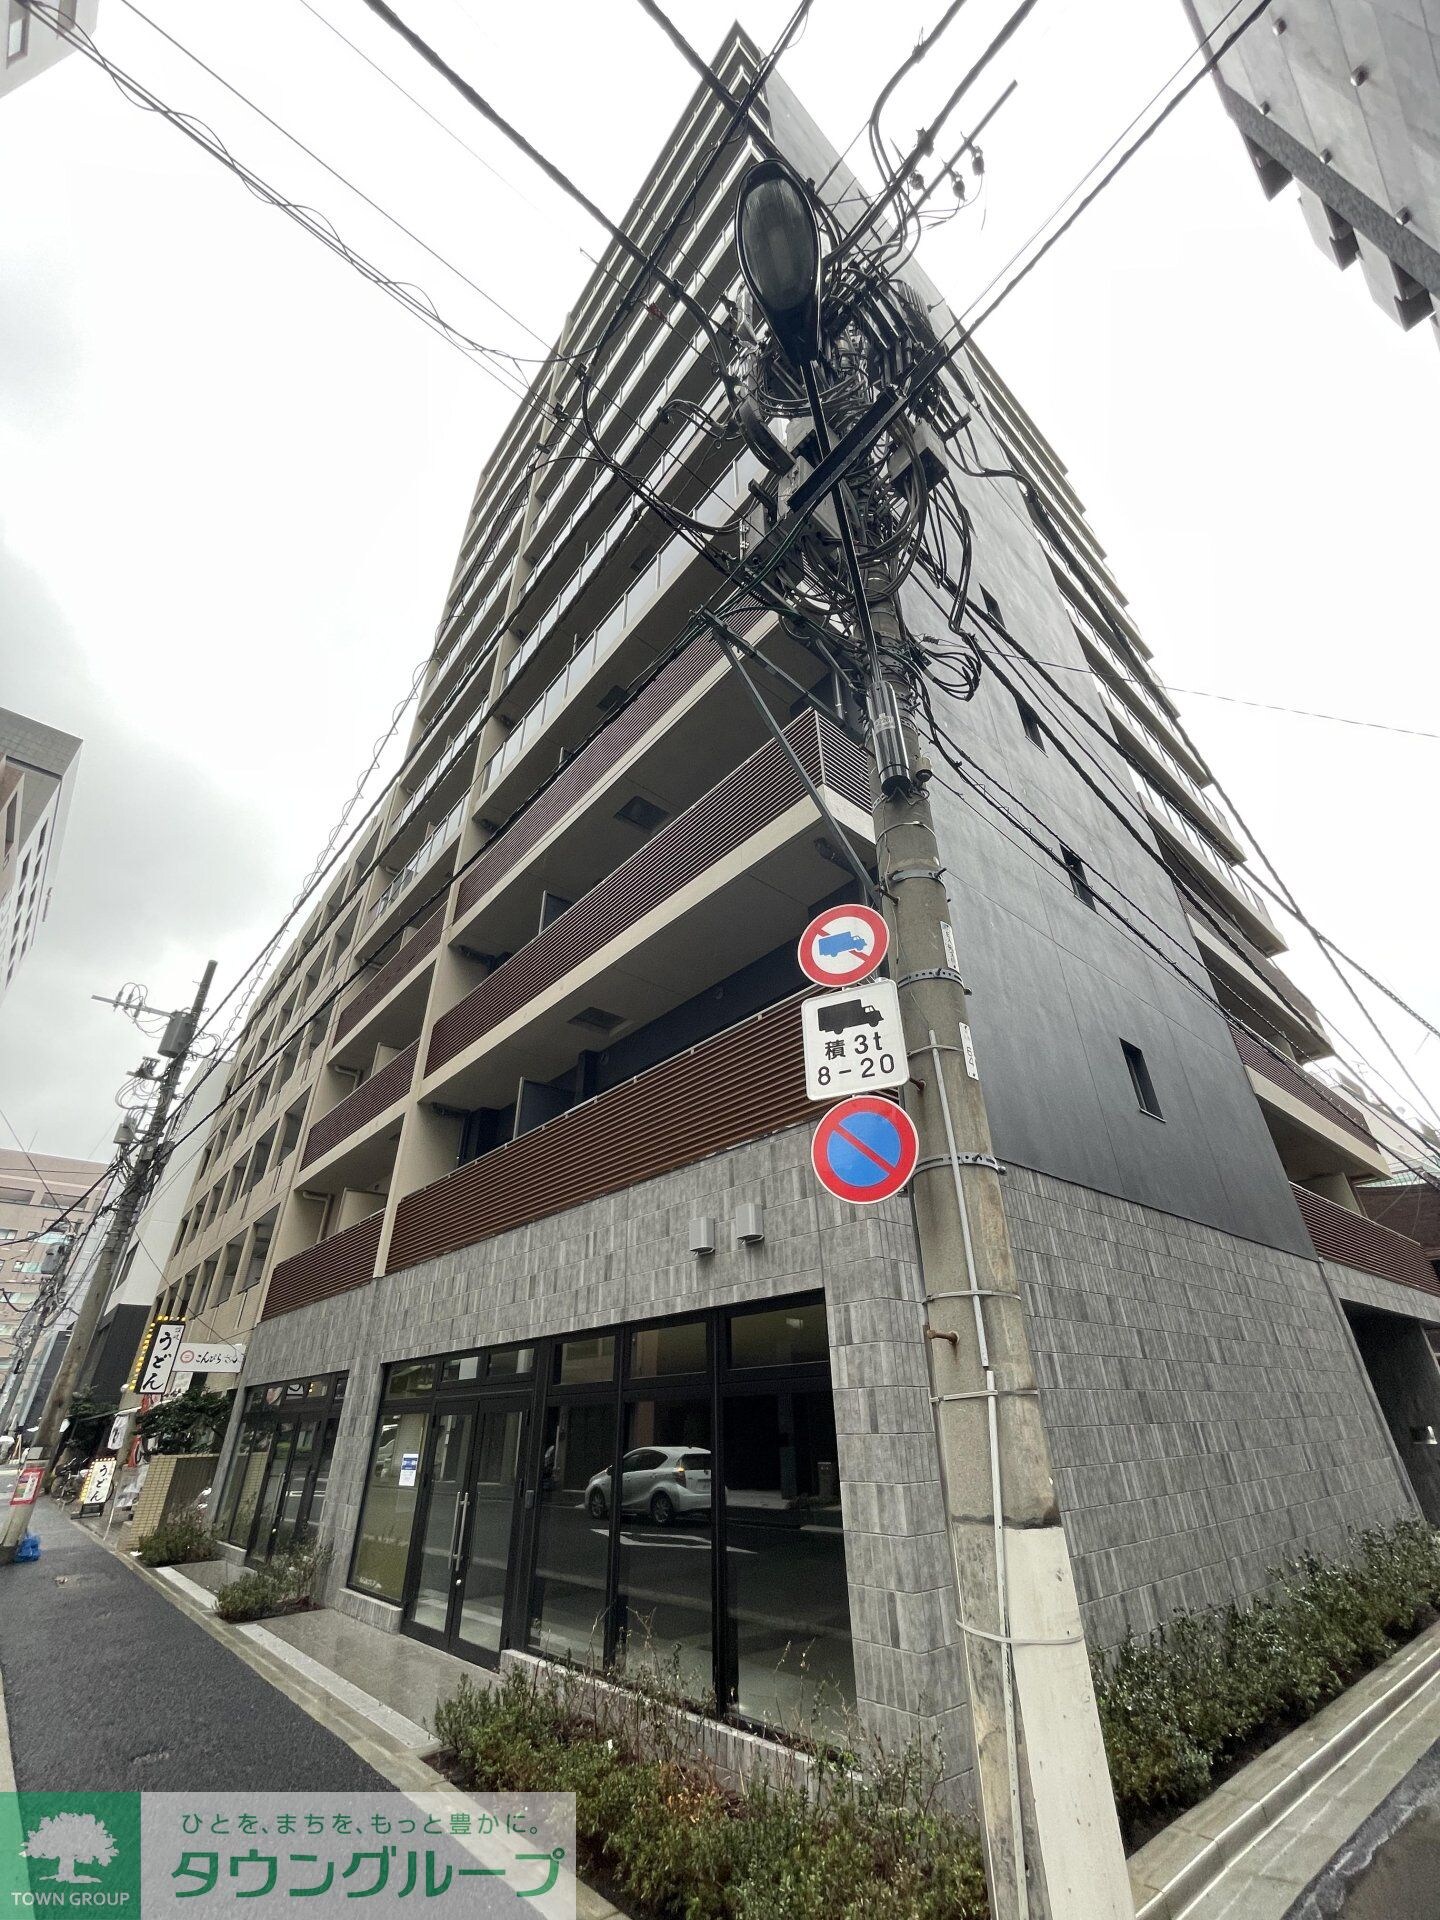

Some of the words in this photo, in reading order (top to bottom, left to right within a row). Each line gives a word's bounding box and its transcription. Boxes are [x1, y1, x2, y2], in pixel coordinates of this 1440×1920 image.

[142, 1331, 172, 1390] うどん
[90, 1464, 108, 1502] うどん
